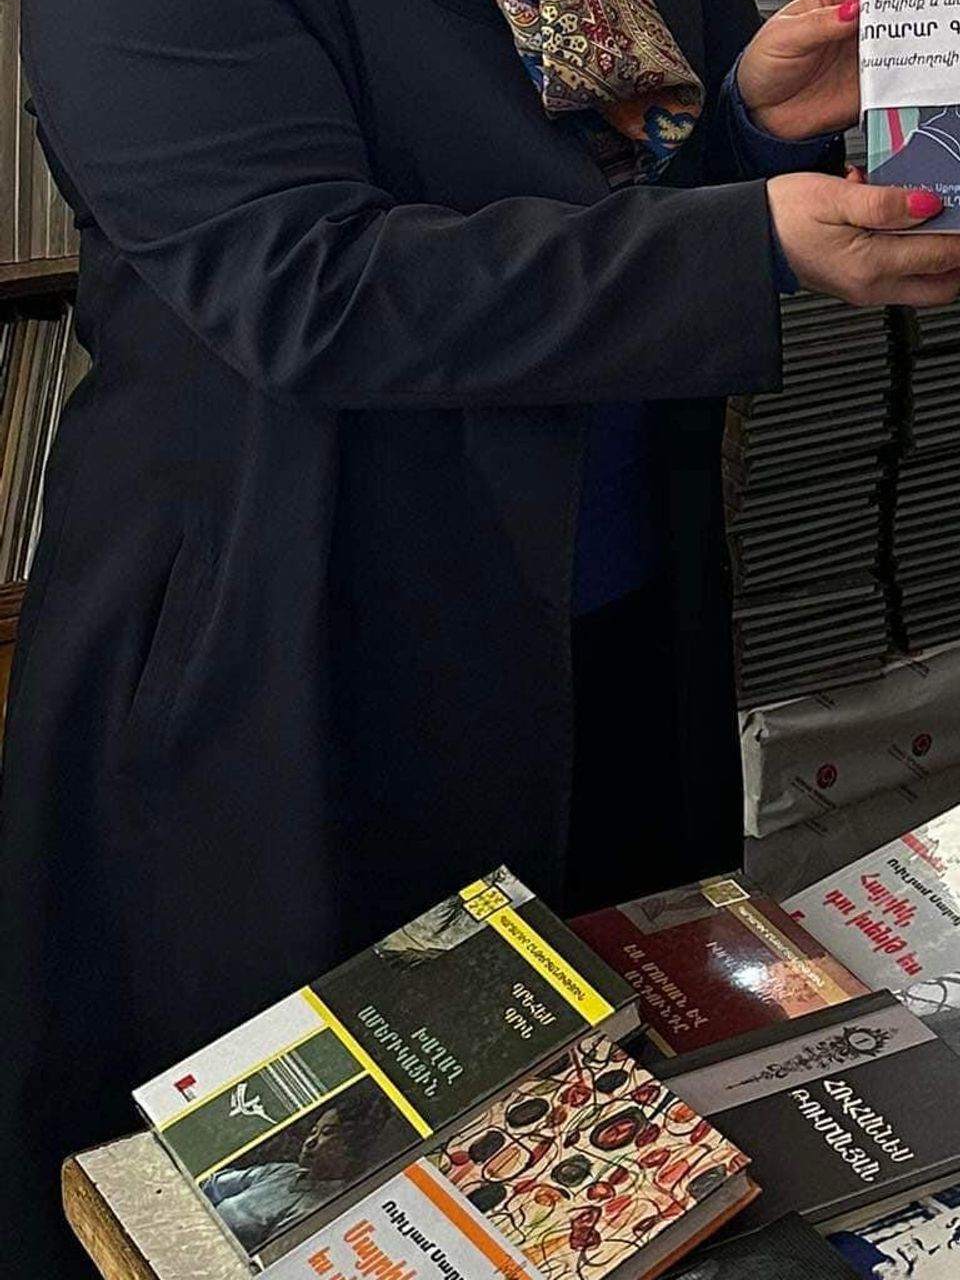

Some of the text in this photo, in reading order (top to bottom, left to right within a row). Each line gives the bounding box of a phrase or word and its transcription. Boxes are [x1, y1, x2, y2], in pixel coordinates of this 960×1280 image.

[504, 1006, 535, 1040] ԳՐԻՆ
[512, 981, 557, 1026] ԳՐԵՀԵՄ
[410, 1025, 464, 1085] ԽԱՂԱՂ
[789, 1088, 880, 1182] ԹՈՒՄԱՆՅԱՆ
[823, 1079, 915, 1162] ՀՈՎՀԱՆՆԵՍ
[381, 1200, 437, 1253] Ուիլյամ
